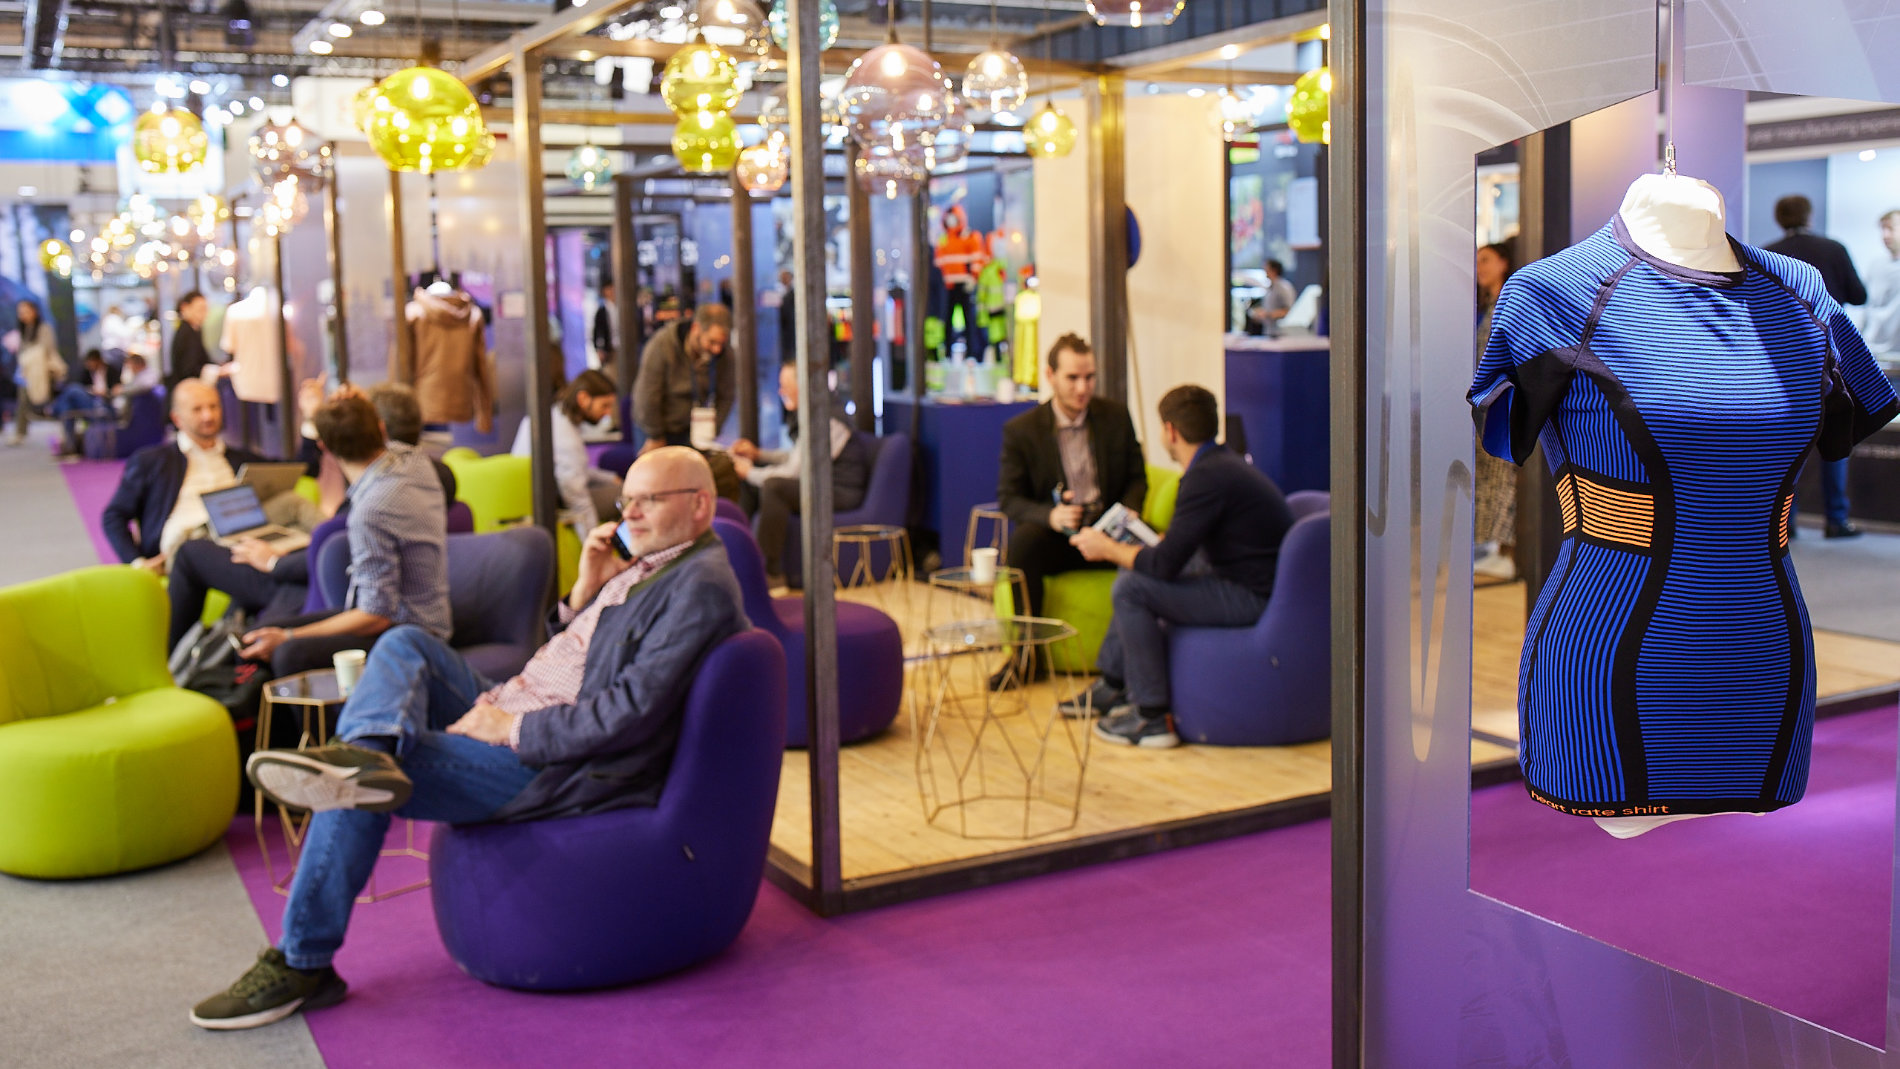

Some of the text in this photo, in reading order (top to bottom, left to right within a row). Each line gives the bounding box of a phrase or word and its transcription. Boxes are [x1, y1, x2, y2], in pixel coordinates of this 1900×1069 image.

[1531, 790, 1669, 817] heart rate shirt
